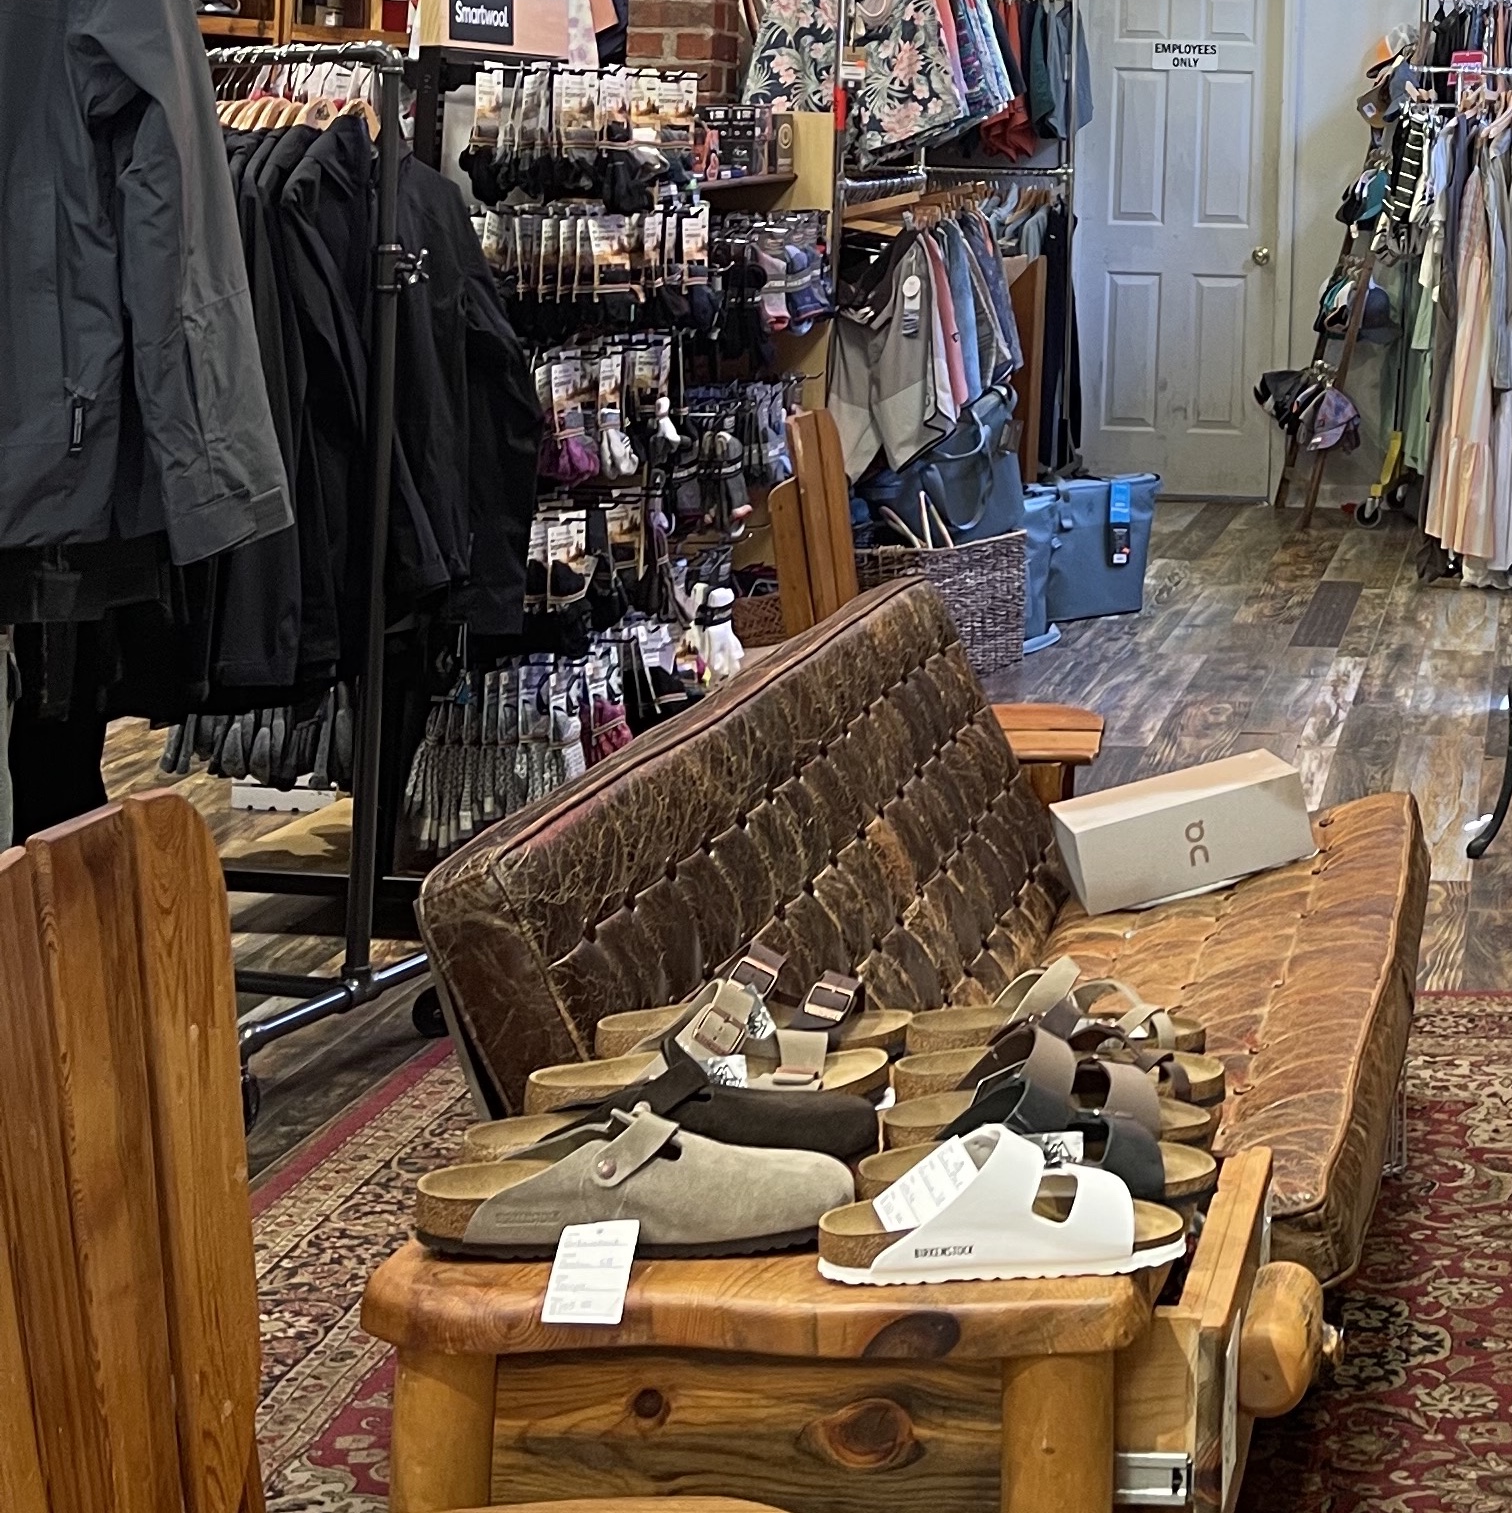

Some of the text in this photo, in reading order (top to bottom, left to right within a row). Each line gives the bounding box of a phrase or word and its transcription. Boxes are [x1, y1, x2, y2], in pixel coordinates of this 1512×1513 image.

[455, 0, 508, 27] Smartwool
[1154, 43, 1217, 55] EMPLOYEES
[1172, 57, 1200, 68] ONLY
